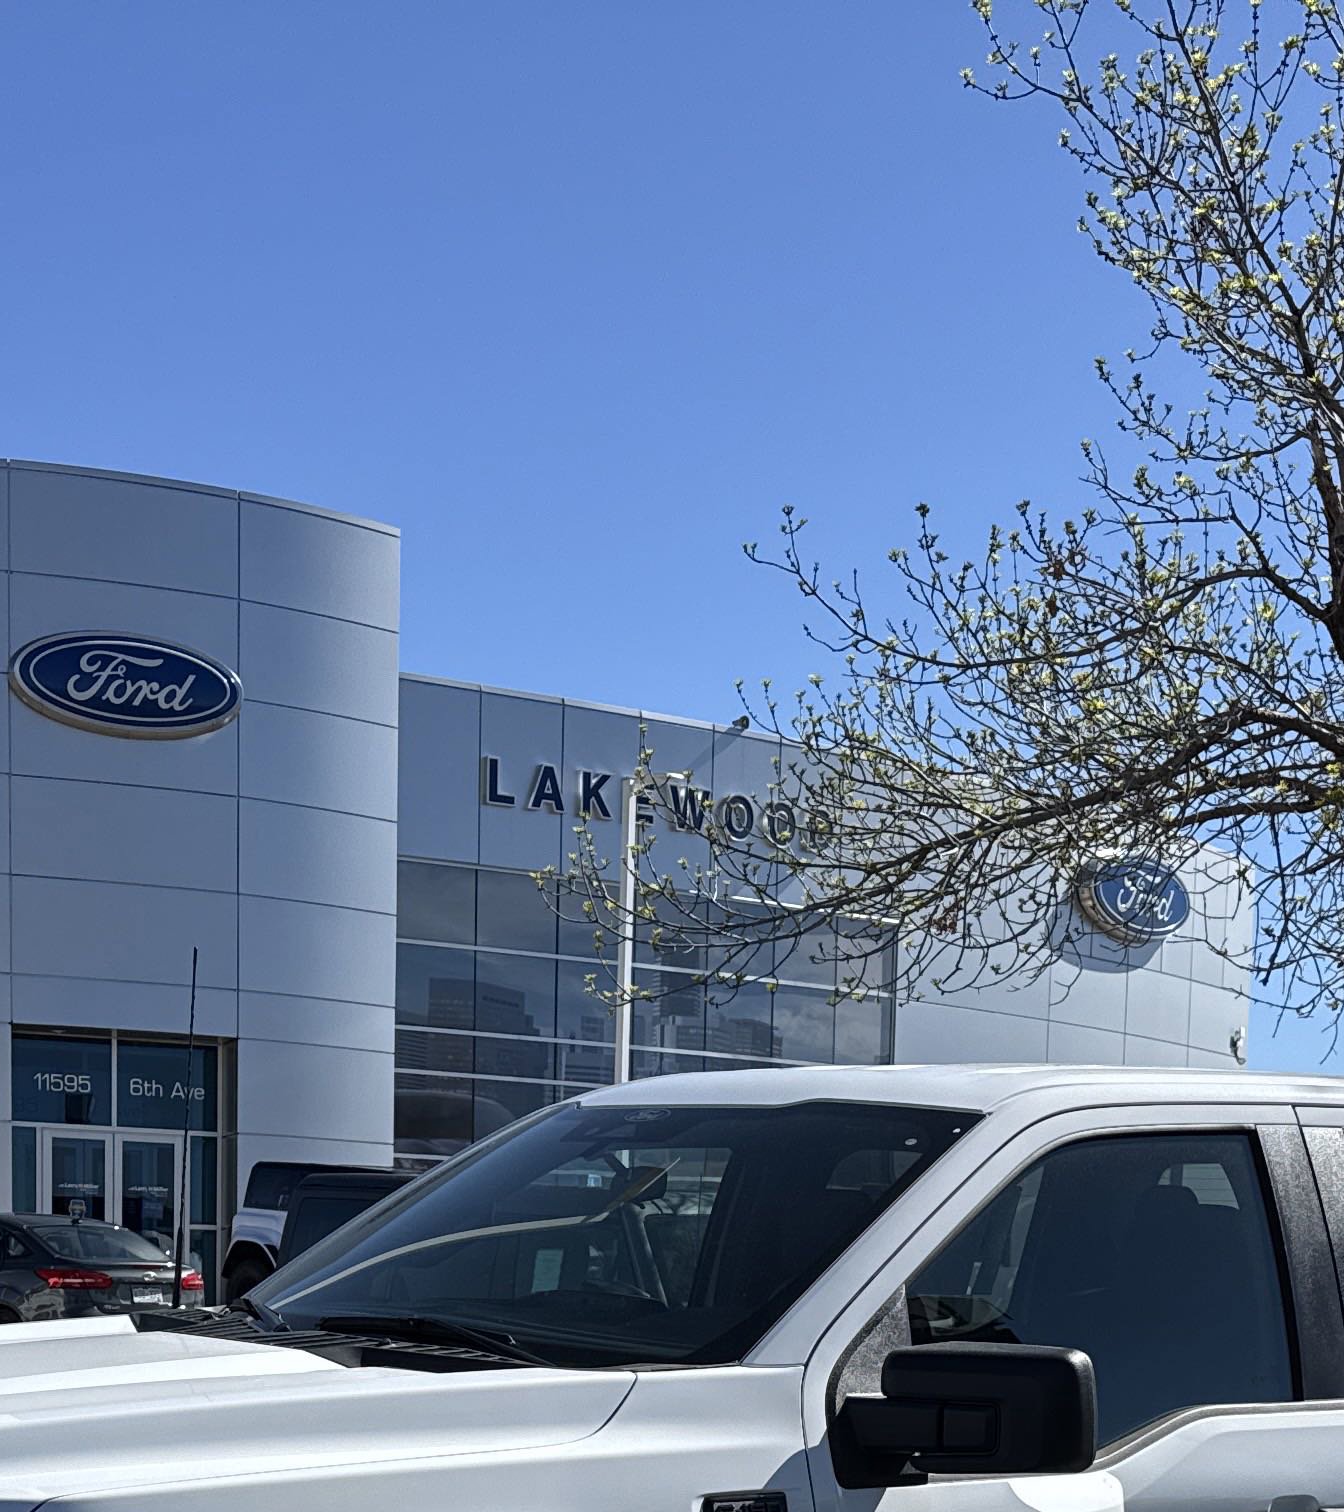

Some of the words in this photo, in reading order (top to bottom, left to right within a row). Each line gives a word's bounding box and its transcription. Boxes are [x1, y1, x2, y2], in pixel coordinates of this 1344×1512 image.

[67, 650, 196, 711] Ford
[33, 1072, 91, 1093] 11595
[130, 1078, 163, 1098] 6th
[170, 1082, 205, 1101] Ave
